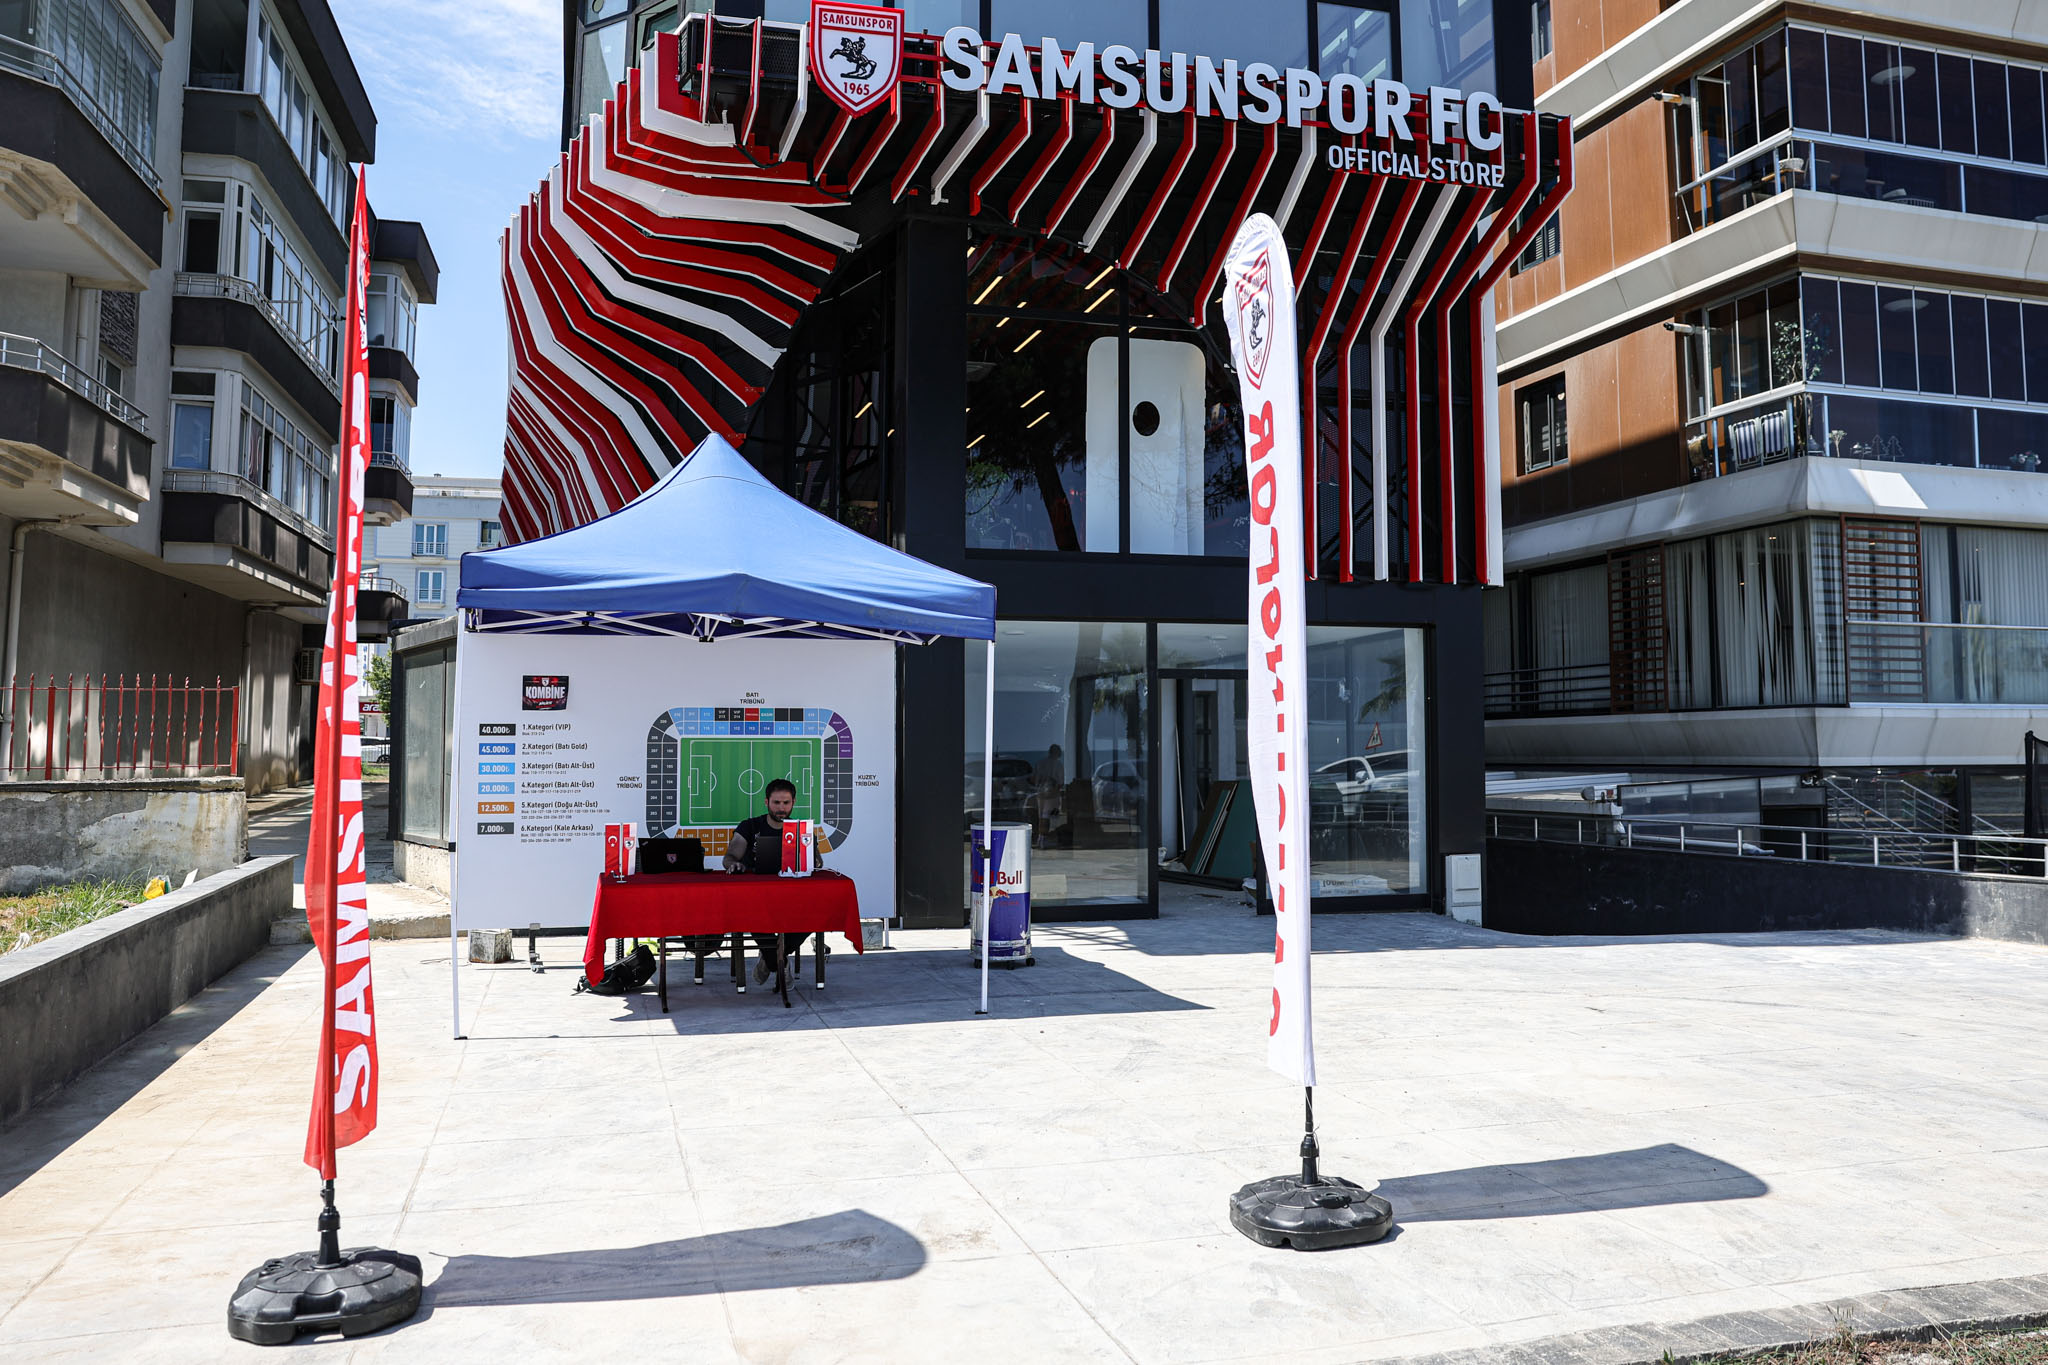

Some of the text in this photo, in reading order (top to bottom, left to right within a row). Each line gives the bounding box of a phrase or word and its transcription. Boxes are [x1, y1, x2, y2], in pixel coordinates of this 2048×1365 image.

[823, 14, 892, 29] SAMSUNSPOR
[844, 82, 870, 95] 1965
[940, 26, 1502, 151] SAMSUNSPOR FC
[1328, 145, 1504, 188] OFFICIAL STORE
[526, 684, 566, 699] KOMBİNE
[522, 724, 554, 732] 1.Kategori
[522, 744, 554, 752] 2.Kategori
[570, 761, 595, 770] Alt-Üst)
[570, 780, 595, 789] Alt-Üst)
[997, 870, 1022, 885] Bull
